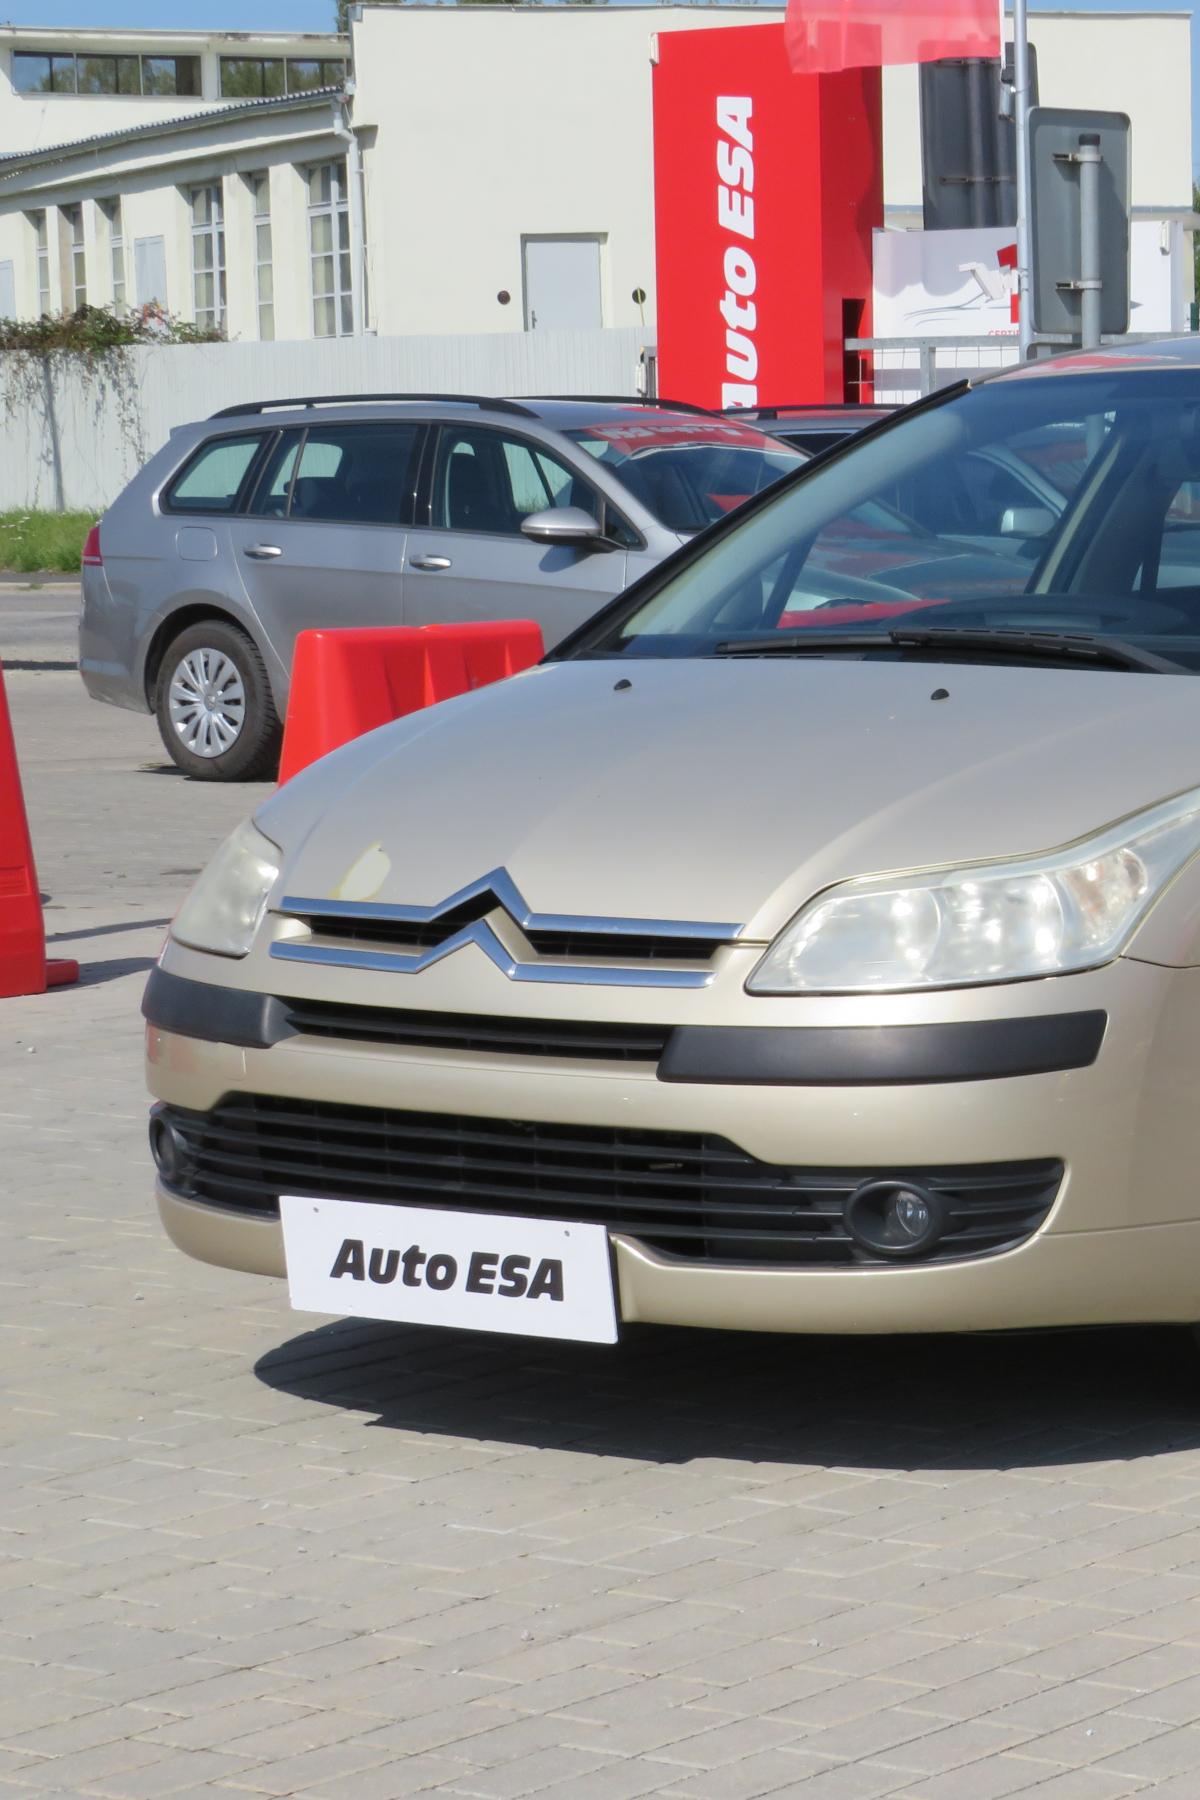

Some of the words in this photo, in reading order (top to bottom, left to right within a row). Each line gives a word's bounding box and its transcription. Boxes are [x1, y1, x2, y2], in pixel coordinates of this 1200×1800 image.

[716, 95, 756, 240] ESA
[329, 1238, 458, 1291] Auto
[465, 1251, 564, 1302] ESA
